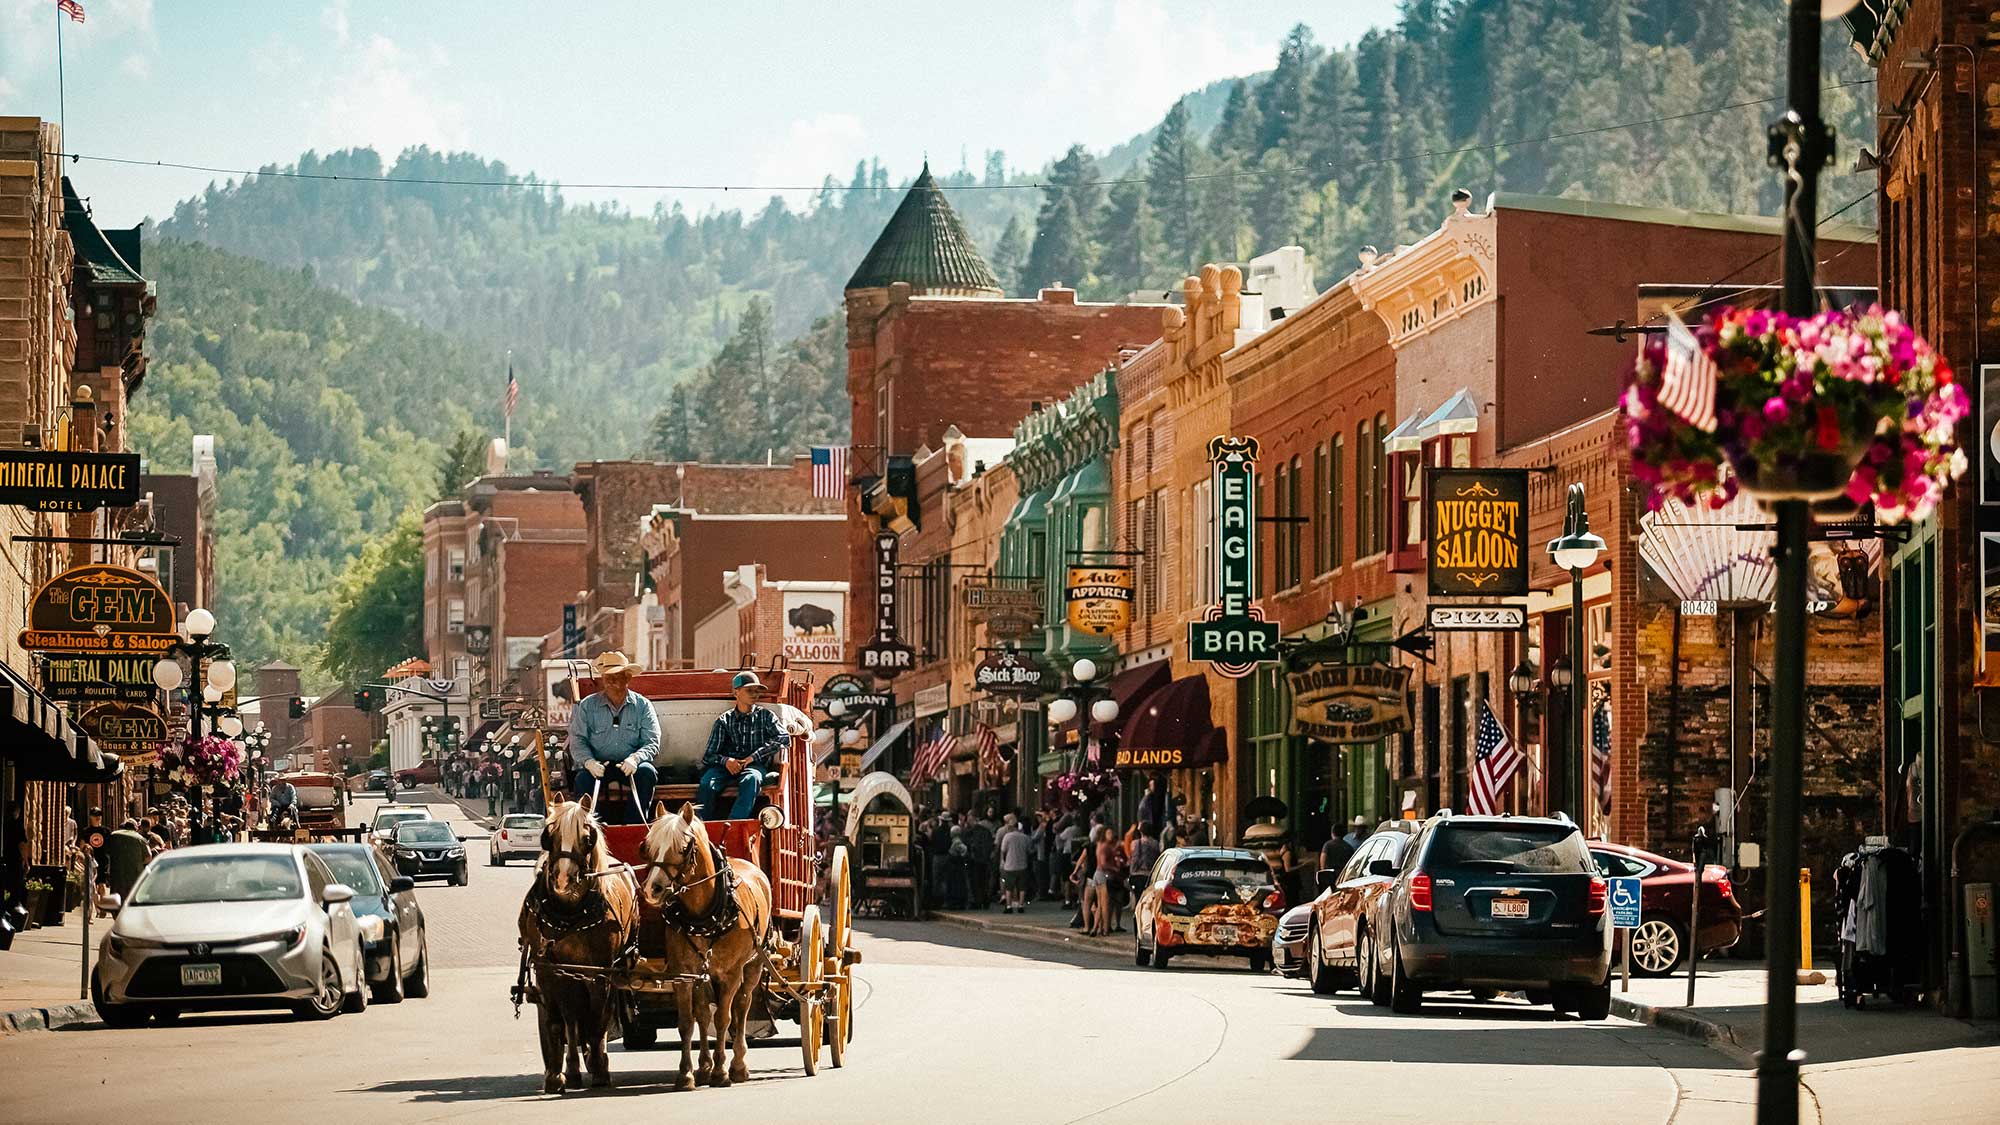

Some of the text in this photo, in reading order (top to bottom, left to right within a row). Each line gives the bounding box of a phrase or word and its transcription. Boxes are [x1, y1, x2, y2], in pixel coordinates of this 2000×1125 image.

[0, 462, 125, 489] MINERAL PALACE
[40, 500, 82, 510] HOTEL
[1436, 500, 1519, 540] NUGGET
[1224, 477, 1245, 616] EAGLE
[1436, 529, 1518, 569] SALOON
[880, 538, 894, 642] WILD BILL
[1072, 587, 1128, 599] APPAREL
[50, 586, 156, 624] The GEM
[1682, 601, 1716, 614] 80428
[1434, 611, 1520, 624] PIZZA
[25, 634, 108, 648] Steakhouse
[112, 635, 125, 649] &
[1204, 630, 1266, 653] BAR
[785, 645, 840, 660] SALOON
[865, 650, 910, 667] BAR
[49, 659, 155, 684] MINERAL PALACE
[978, 666, 1040, 685] Sick Boy
[57, 687, 147, 698] SLOTS ROULETTE CARDS
[100, 715, 158, 739] GEM
[1133, 749, 1182, 764] LANDS
